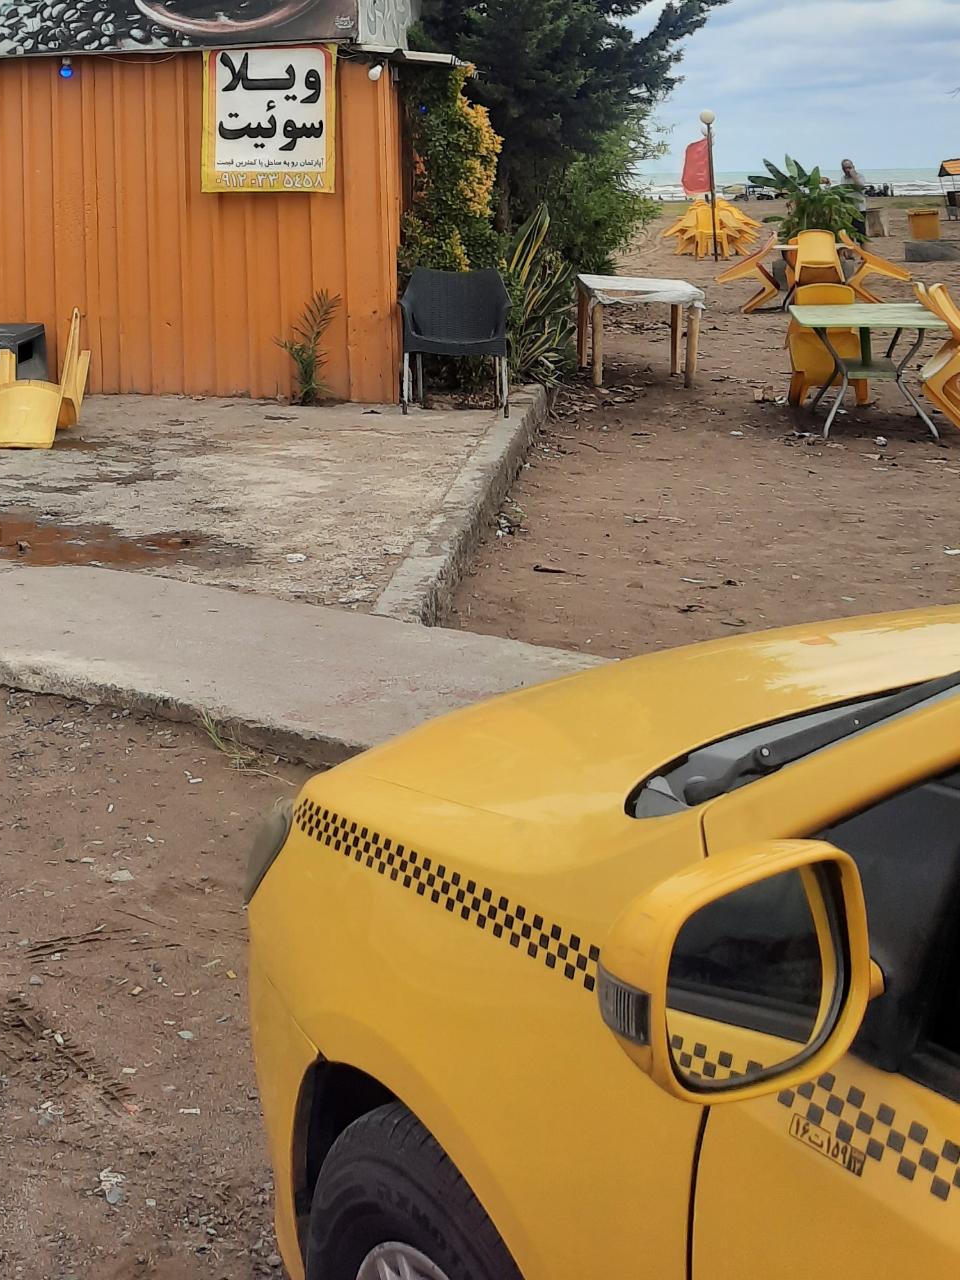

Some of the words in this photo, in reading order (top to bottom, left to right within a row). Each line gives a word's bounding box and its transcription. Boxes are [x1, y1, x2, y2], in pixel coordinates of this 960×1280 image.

[219, 51, 322, 104] ویلا
[218, 99, 324, 152] سوئیت
[264, 158, 282, 167] ساحل
